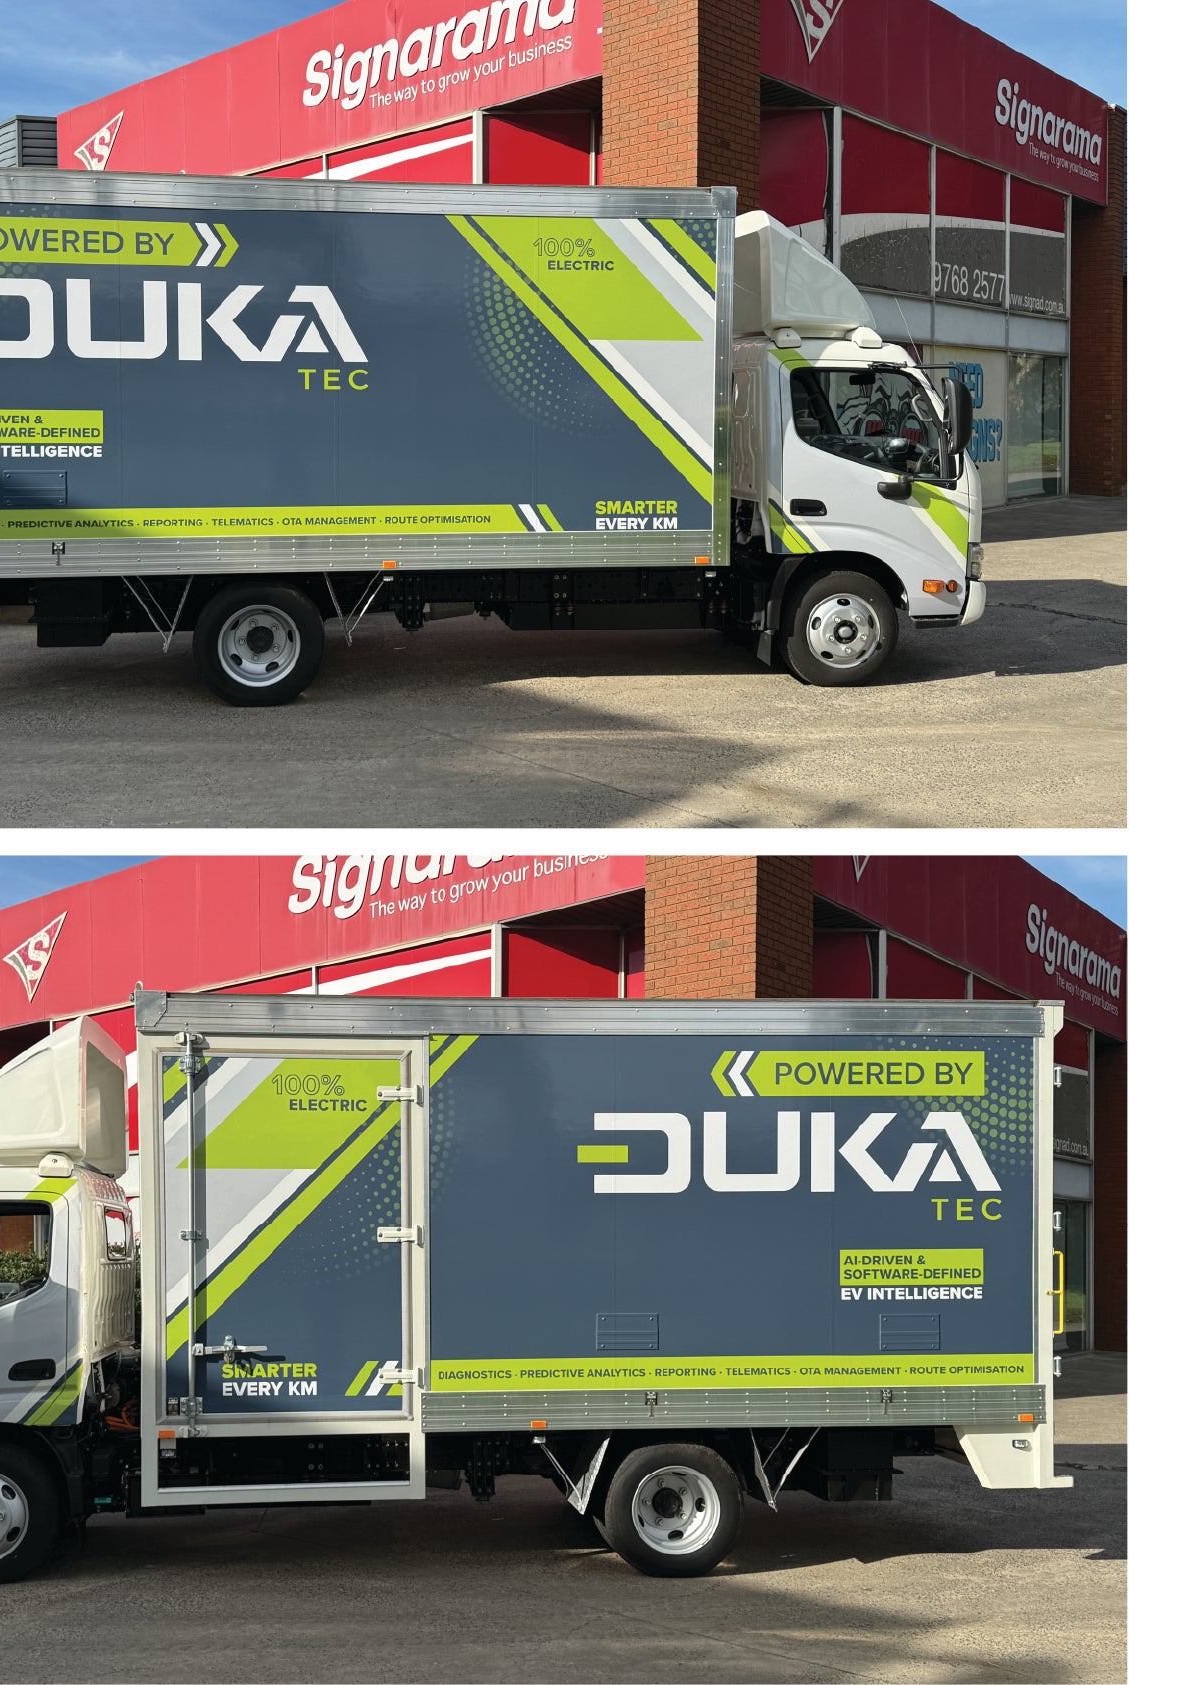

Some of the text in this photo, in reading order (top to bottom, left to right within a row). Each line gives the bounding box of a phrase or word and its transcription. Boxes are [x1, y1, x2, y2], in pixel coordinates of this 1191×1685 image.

[302, 0, 576, 110] Signarama
[369, 35, 572, 108] The way to grow your business
[995, 78, 1102, 166] Signarama
[1029, 142, 1038, 158] The
[1040, 150, 1050, 164] way
[135, 232, 174, 256] BY
[533, 238, 595, 258] 100%
[548, 260, 614, 270] ELECTRIC
[934, 262, 1005, 302] 9768 2577
[298, 368, 370, 390] TEC
[34, 416, 43, 424] &
[596, 500, 678, 514] SMARTER
[8, 520, 72, 528] PREDICTIVE
[74, 520, 134, 528] ANALYTICS
[142, 518, 203, 527] REPORTING
[212, 518, 274, 526] TELEMATICS
[282, 518, 302, 526] OTA
[305, 516, 376, 526] MANAGEMENT
[384, 516, 418, 524] ROUTE
[420, 515, 491, 524] OPTIMISATION
[596, 517, 678, 530] EVERY KM
[370, 900, 395, 918] The
[398, 892, 426, 912] way
[430, 886, 446, 904] to
[449, 877, 489, 904] grow
[492, 865, 529, 892] your
[1026, 904, 1122, 998] Signarama
[1056, 972, 1065, 988] The
[774, 1062, 974, 1086] POWERED BY
[272, 1074, 345, 1096] 100%
[289, 1099, 367, 1112] ELECTRIC
[577, 1111, 1002, 1194] DUKA
[932, 1198, 1002, 1221] TEC
[844, 1255, 926, 1265] AI-DRIVEN &
[844, 1268, 981, 1280] SOFTWARE-DEFINED
[840, 1286, 982, 1300] EV INTELLIGENCE
[222, 1363, 318, 1378] SMARTER
[438, 1366, 1024, 1380] DIAGNOSTICS PREDICTIVE ANALYTICS REPORTING TELEMATICS OTA MANAGEMENT ROUTE OPTIMISATION
[222, 1381, 318, 1396] EVERY KM
